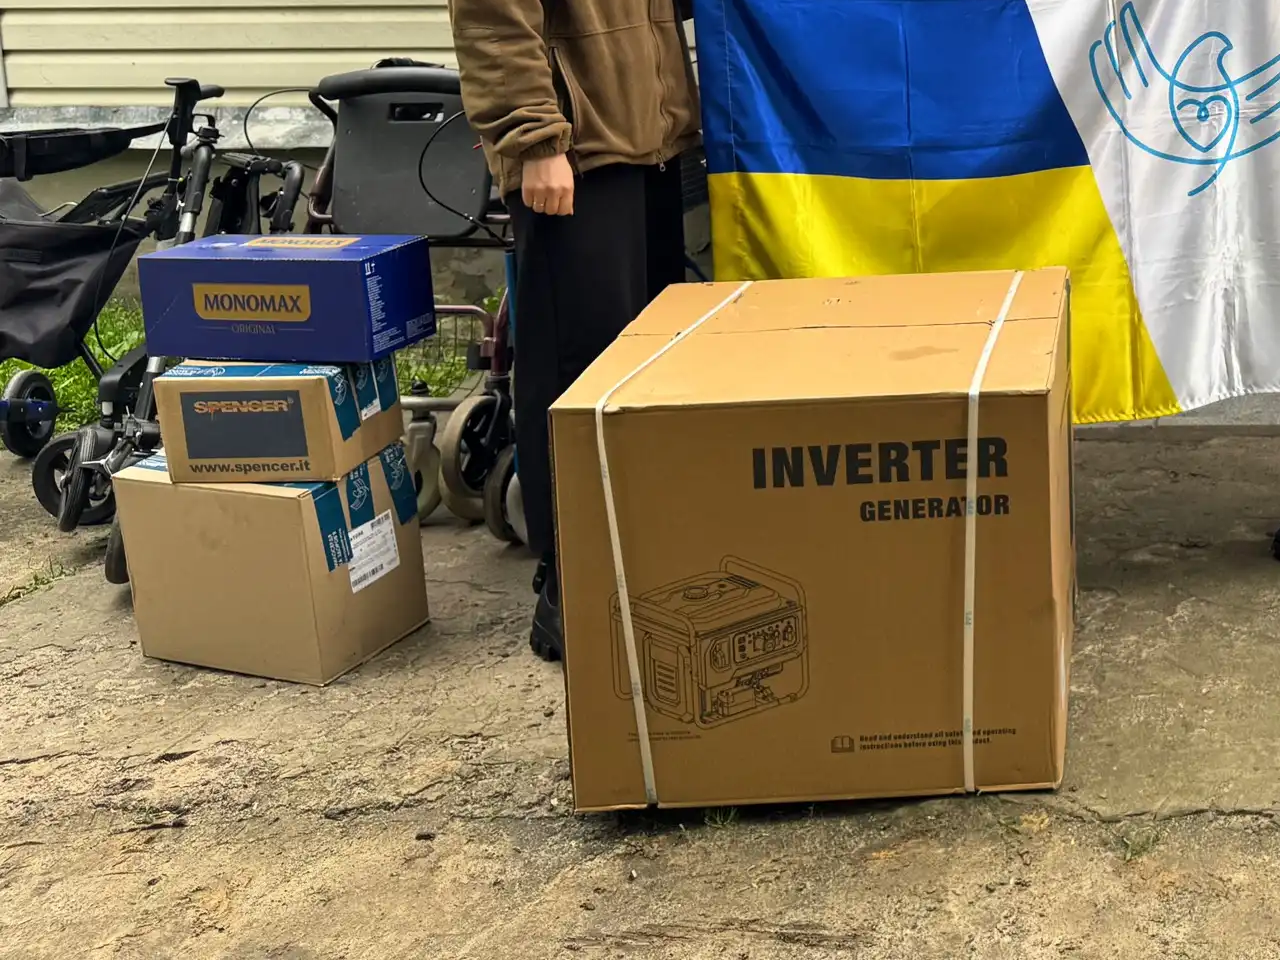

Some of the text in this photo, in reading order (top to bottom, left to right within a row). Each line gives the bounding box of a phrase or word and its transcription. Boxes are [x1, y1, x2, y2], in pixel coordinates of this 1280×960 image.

[203, 293, 303, 314] MONOMAX
[231, 323, 276, 335] ORIGINAL
[194, 400, 289, 414] SPENCER
[189, 459, 311, 474] www.spencer.it
[752, 437, 1008, 489] INVERTER
